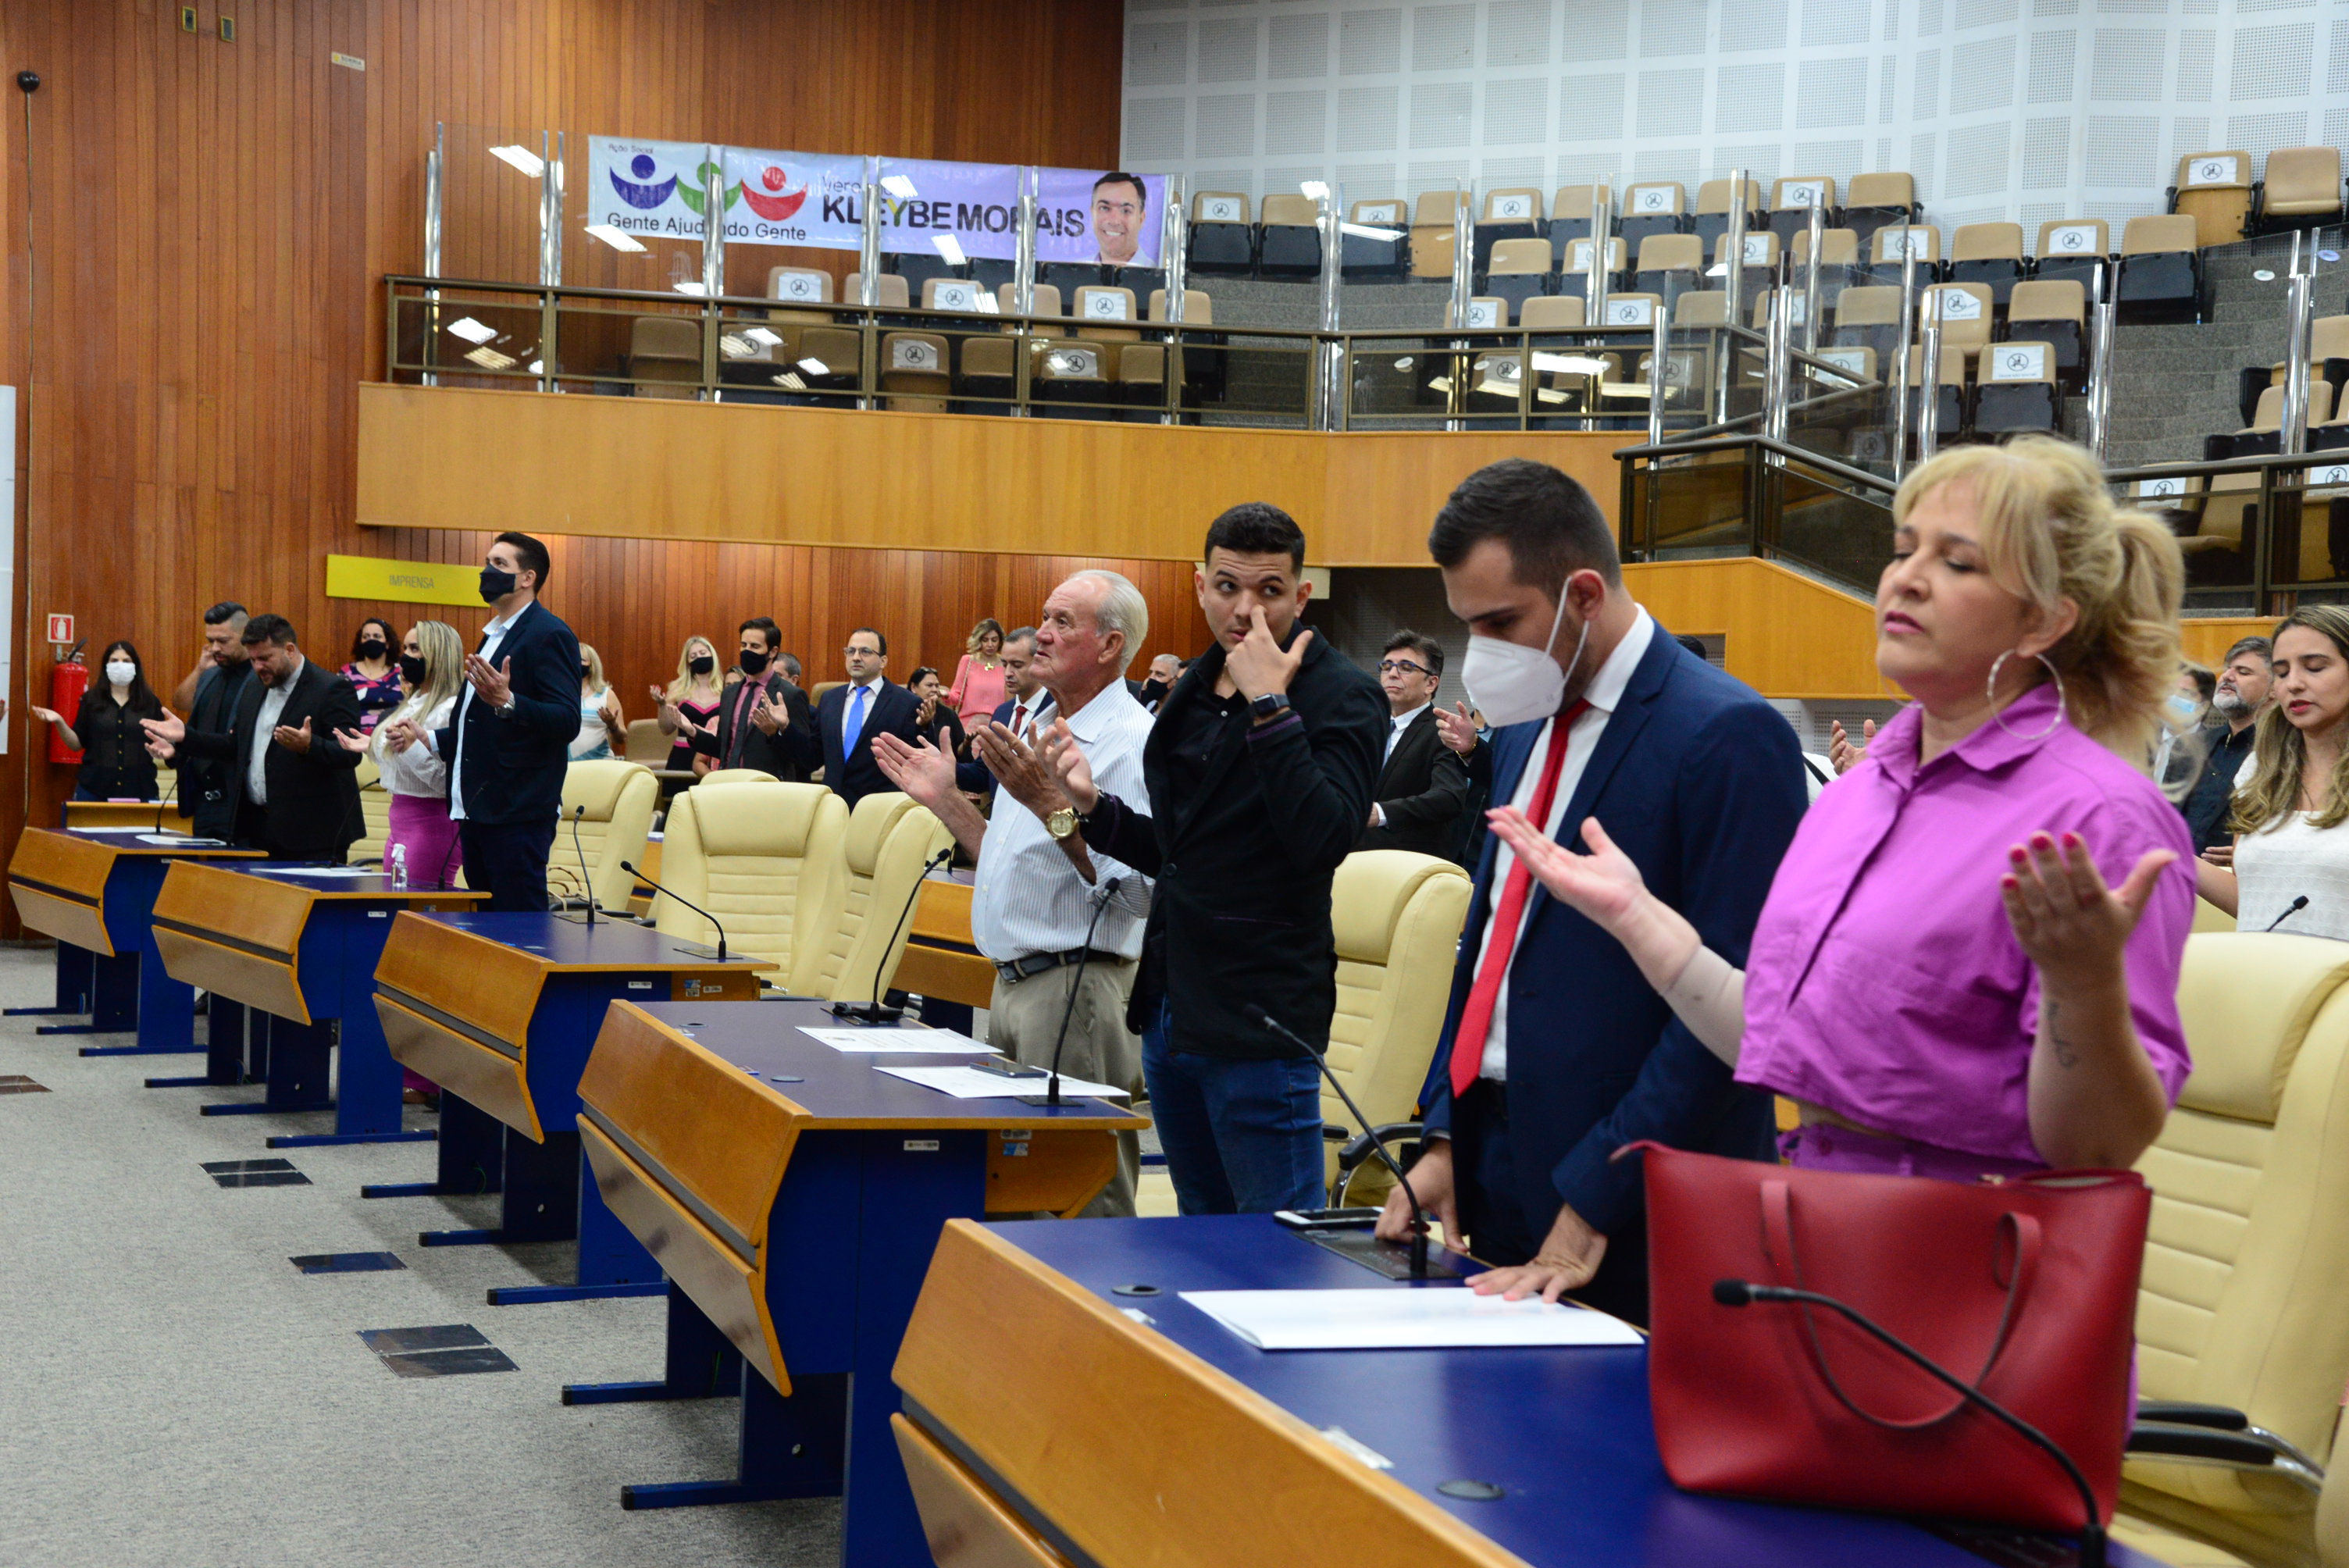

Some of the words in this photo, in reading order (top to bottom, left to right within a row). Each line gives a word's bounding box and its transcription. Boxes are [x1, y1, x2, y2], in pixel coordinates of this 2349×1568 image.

[608, 212, 659, 231] Gente
[665, 217, 749, 237] Ajuddo
[755, 223, 807, 241] Gente
[389, 574, 435, 589] IMPRENSA
